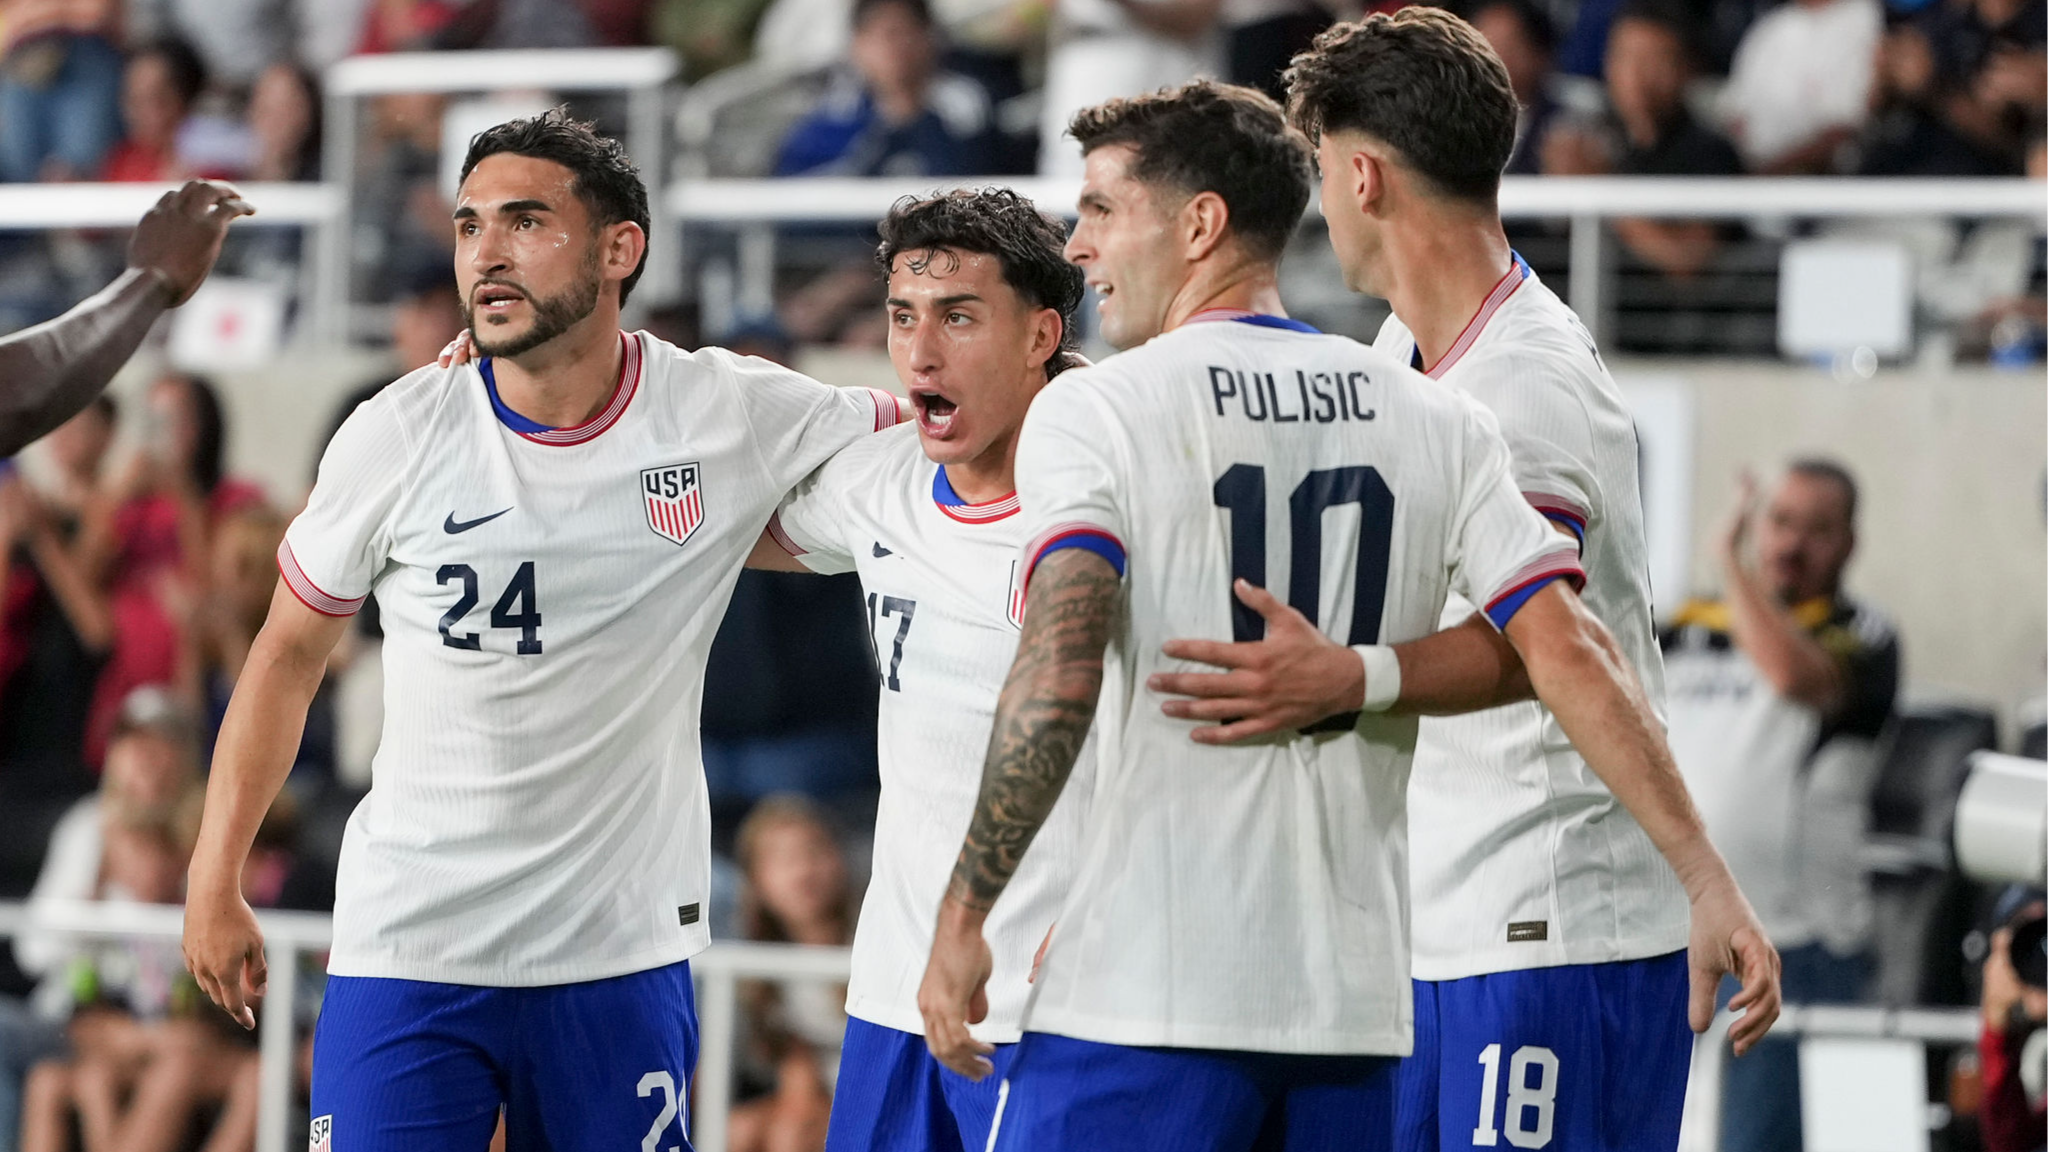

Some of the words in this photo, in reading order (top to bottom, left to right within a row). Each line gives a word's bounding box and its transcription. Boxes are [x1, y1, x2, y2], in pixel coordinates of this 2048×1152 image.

[1208, 365, 1377, 424] PULISIC
[645, 467, 696, 499] USA
[435, 560, 543, 656] 24
[867, 592, 917, 692] 17
[1214, 462, 1396, 735] 10
[636, 1070, 688, 1152] 2
[1471, 1042, 1560, 1151] 18
